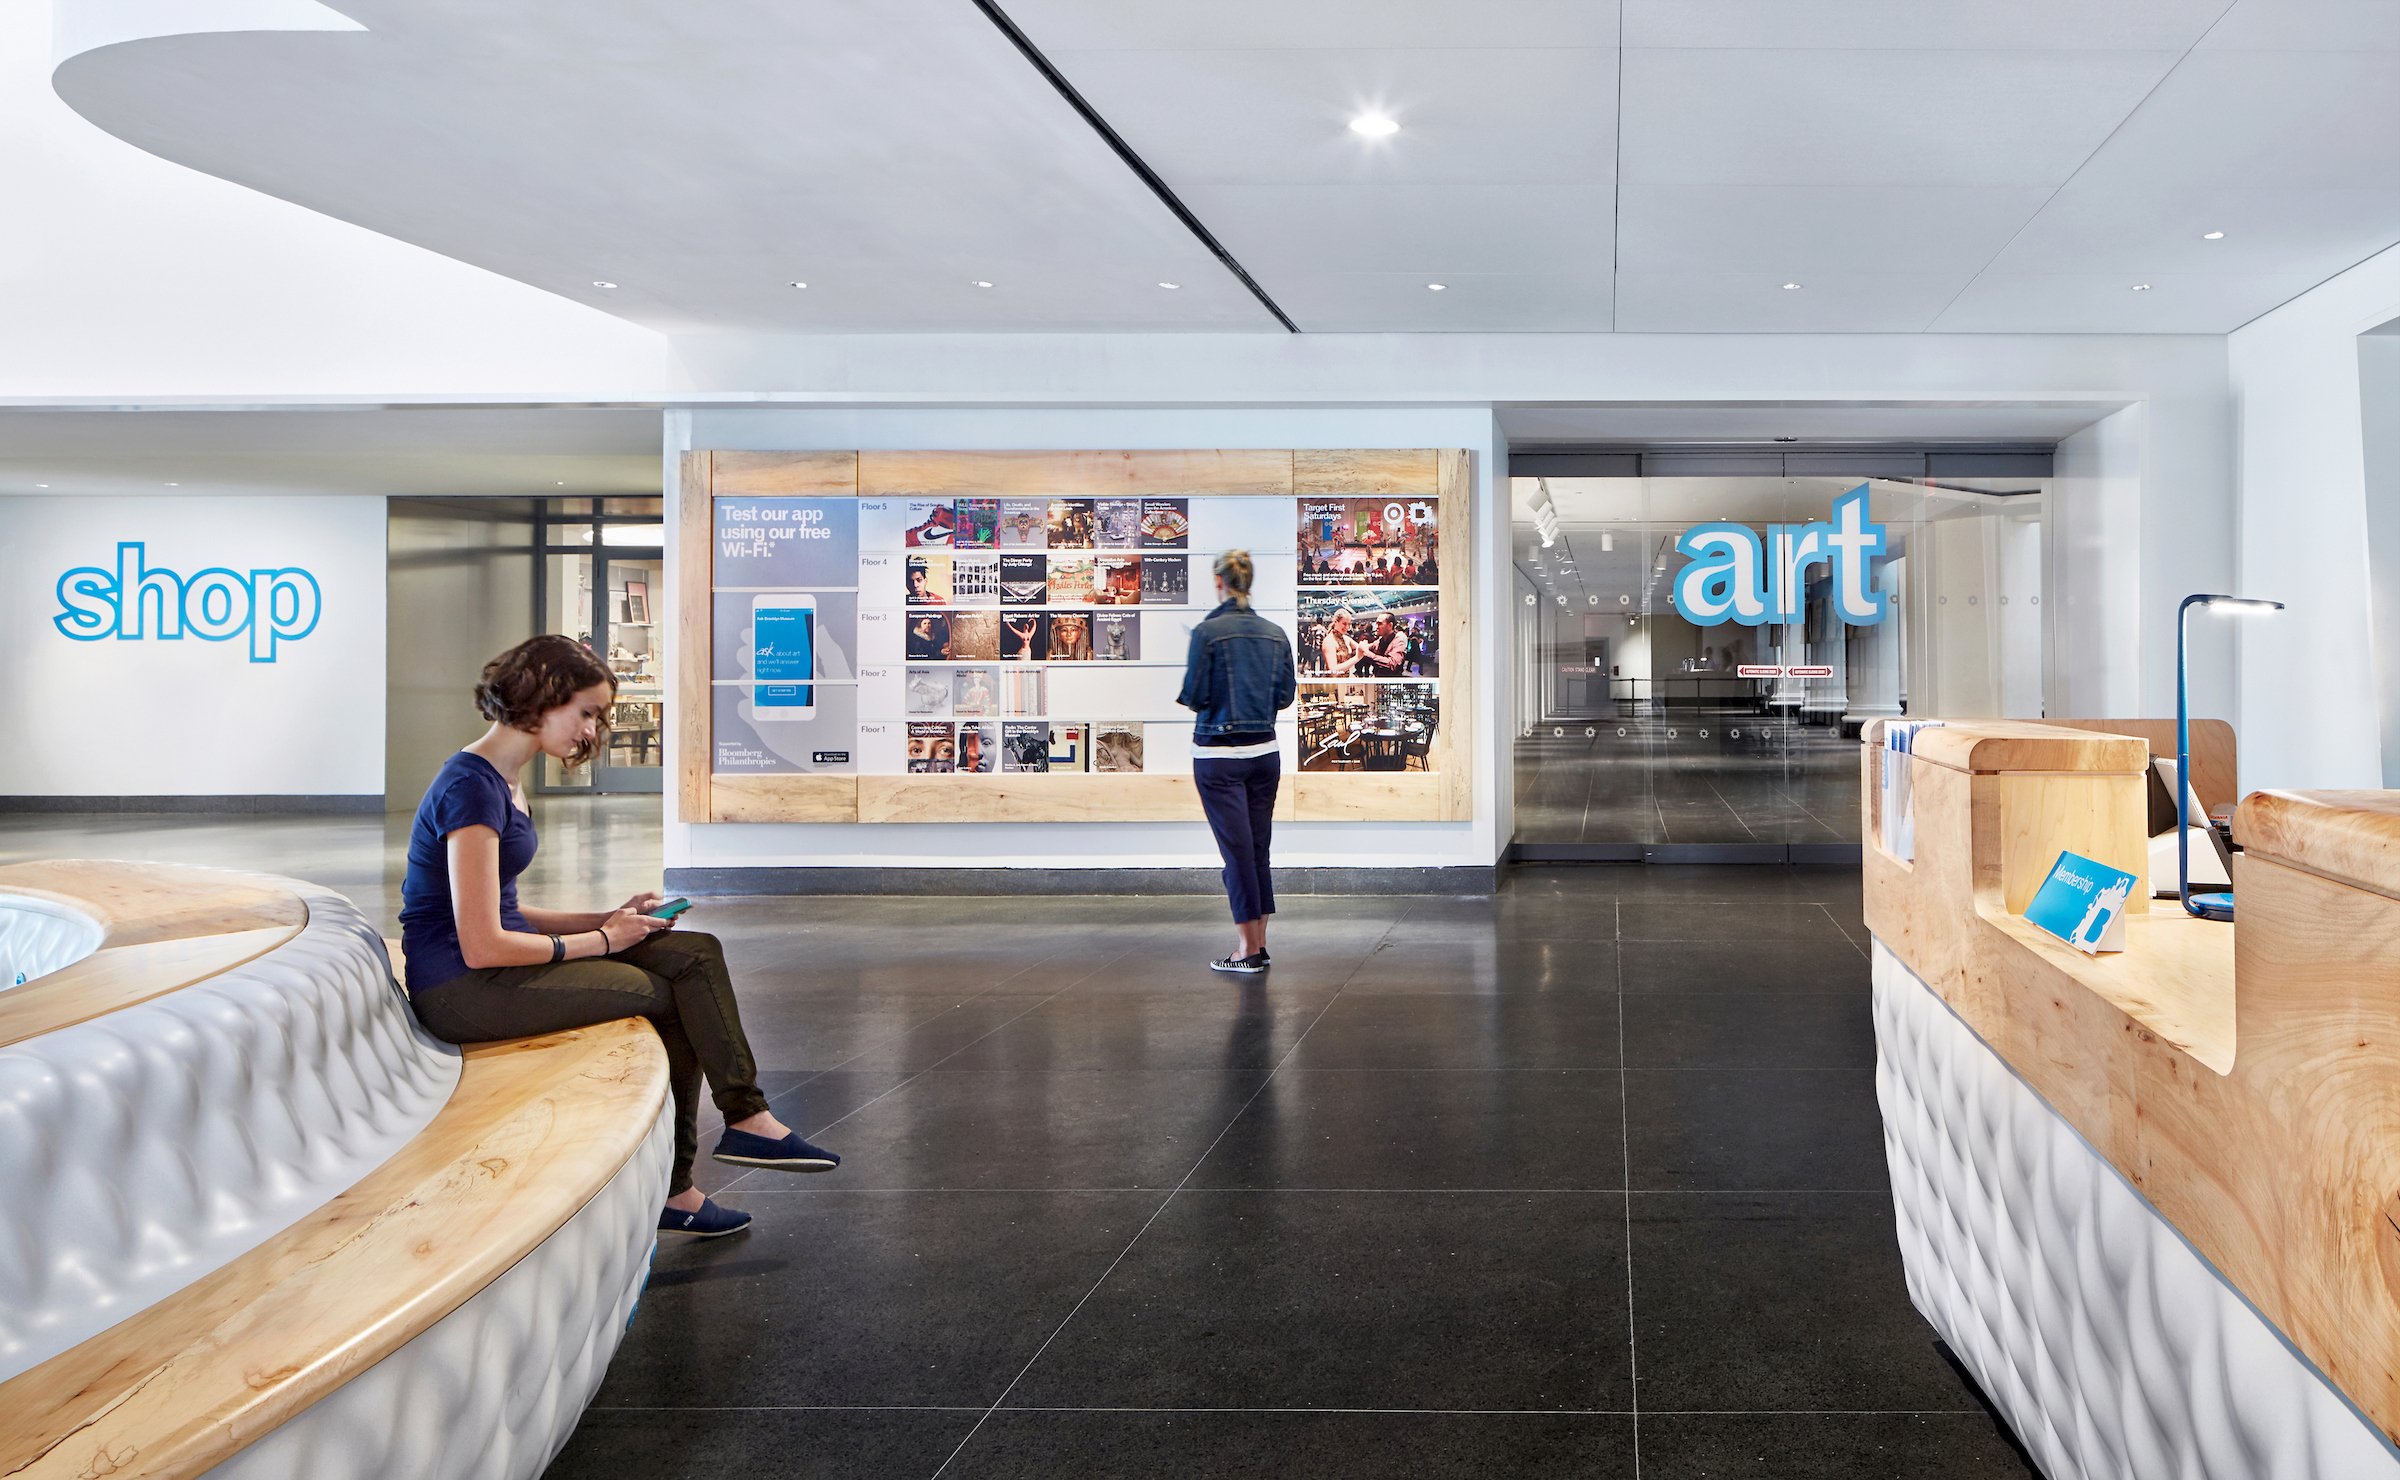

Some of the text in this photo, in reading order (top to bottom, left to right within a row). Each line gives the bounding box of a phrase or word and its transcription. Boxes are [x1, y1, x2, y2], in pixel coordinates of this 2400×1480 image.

[721, 505, 823, 525] Test our app
[1303, 503, 1345, 513] Target First
[1303, 512, 1342, 522] Saturdays
[721, 523, 831, 543] using our free
[1673, 481, 1886, 626] art
[53, 542, 321, 663] shop
[1304, 596, 1340, 606] Thursday
[756, 641, 775, 657] ask
[719, 748, 762, 758] Bloomberg
[719, 757, 776, 767] Philanthropies
[2052, 863, 2094, 896] Membership
[2084, 907, 2111, 944] B
